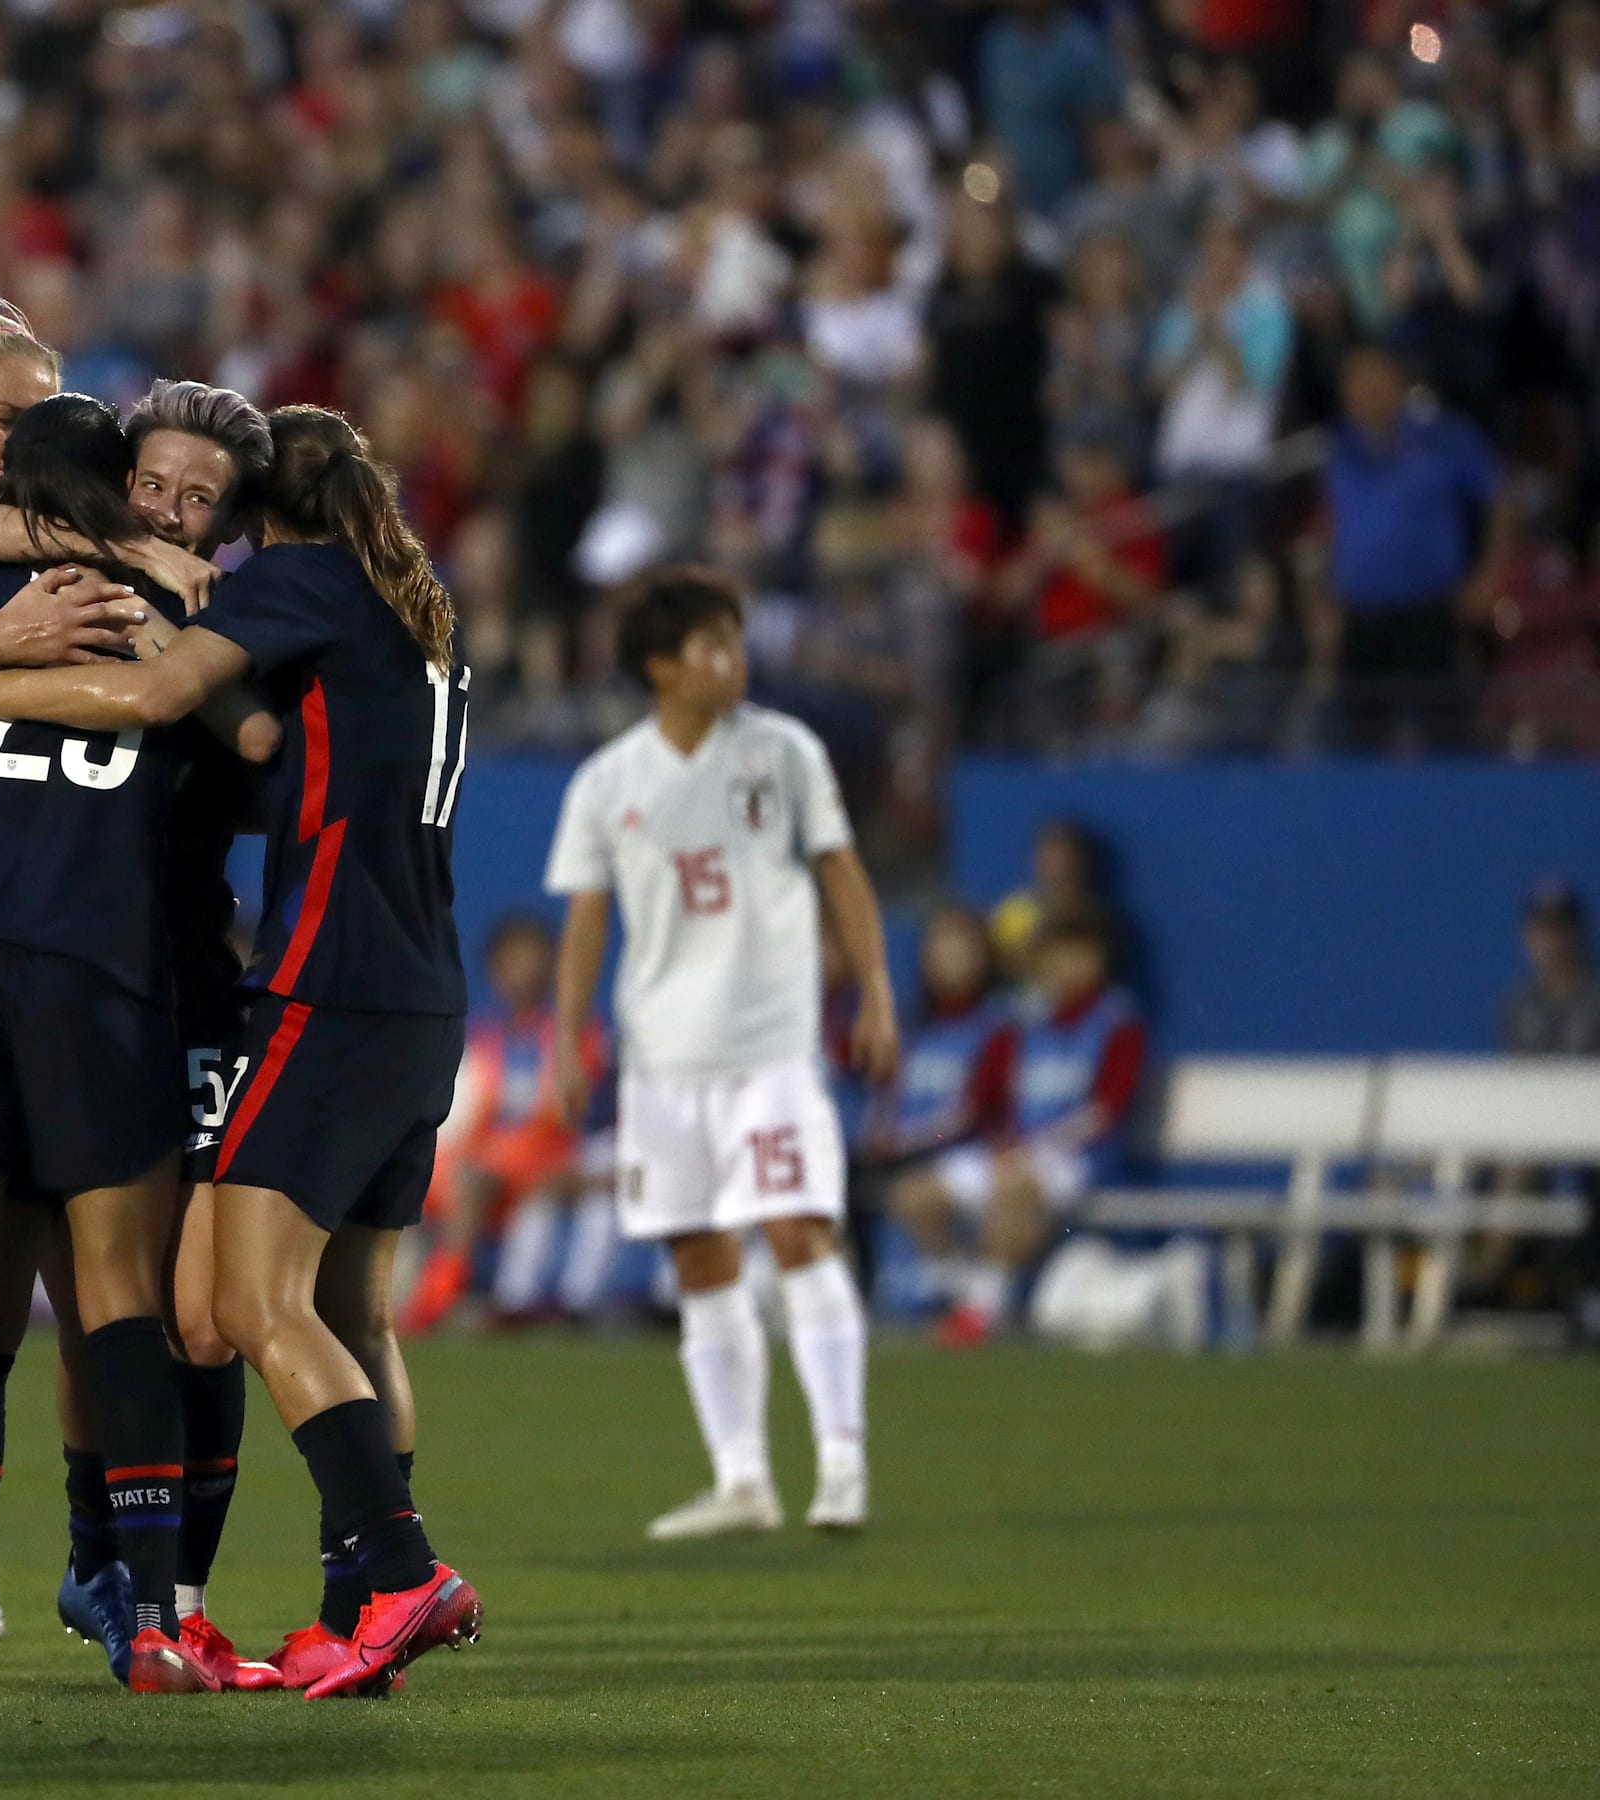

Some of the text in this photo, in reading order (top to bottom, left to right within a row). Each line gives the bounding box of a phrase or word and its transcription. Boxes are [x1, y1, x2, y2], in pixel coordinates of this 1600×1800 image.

[672, 846, 732, 917] 15
[746, 1124, 805, 1193] 15
[109, 1487, 171, 1509] STATES
